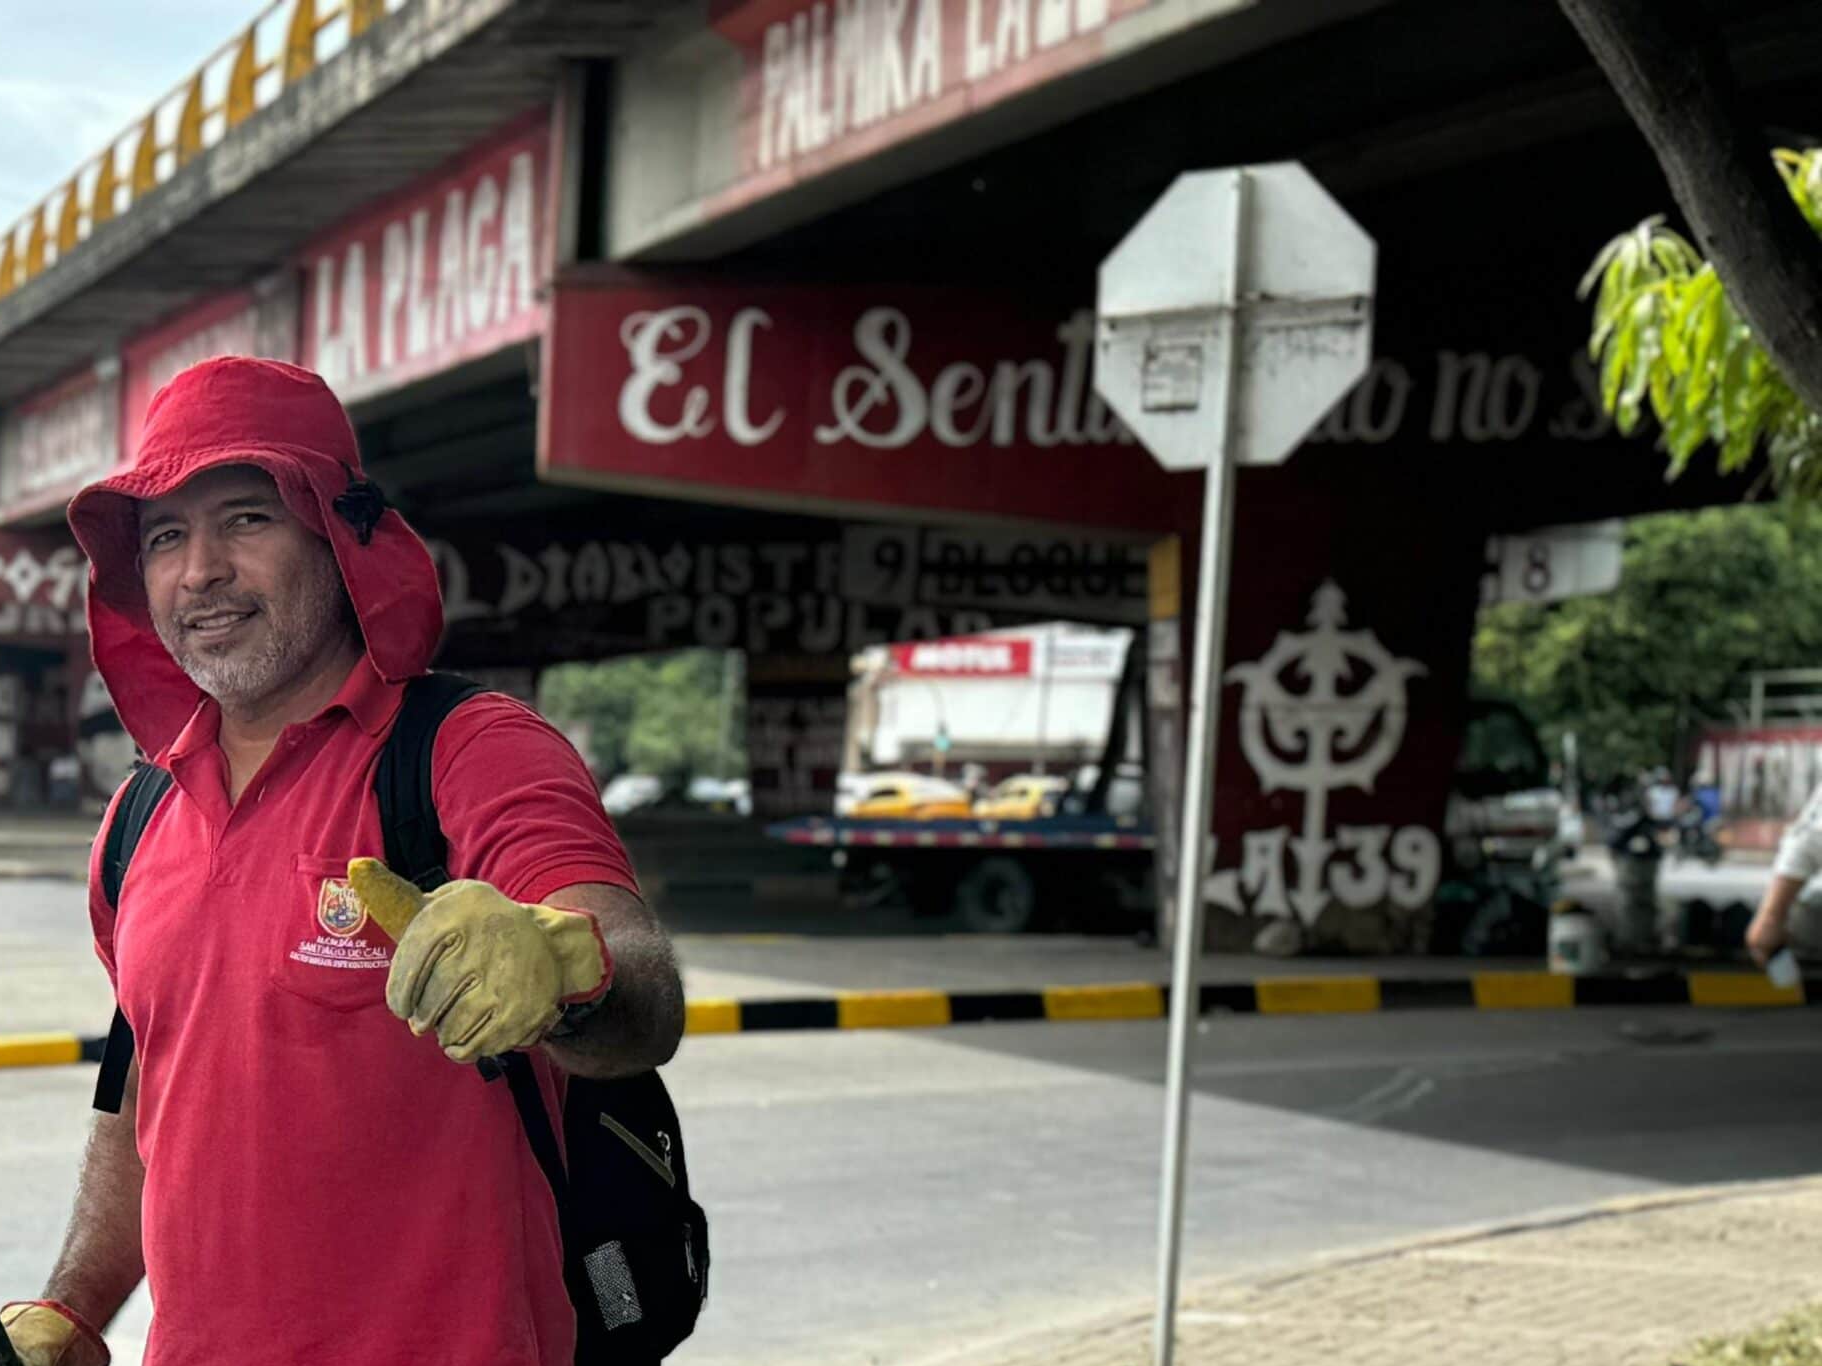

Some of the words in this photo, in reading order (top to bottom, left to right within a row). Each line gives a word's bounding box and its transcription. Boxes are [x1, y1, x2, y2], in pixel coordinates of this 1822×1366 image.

[380, 151, 535, 368] PLAGA
[619, 306, 785, 446] El
[1523, 542, 1552, 594] 8
